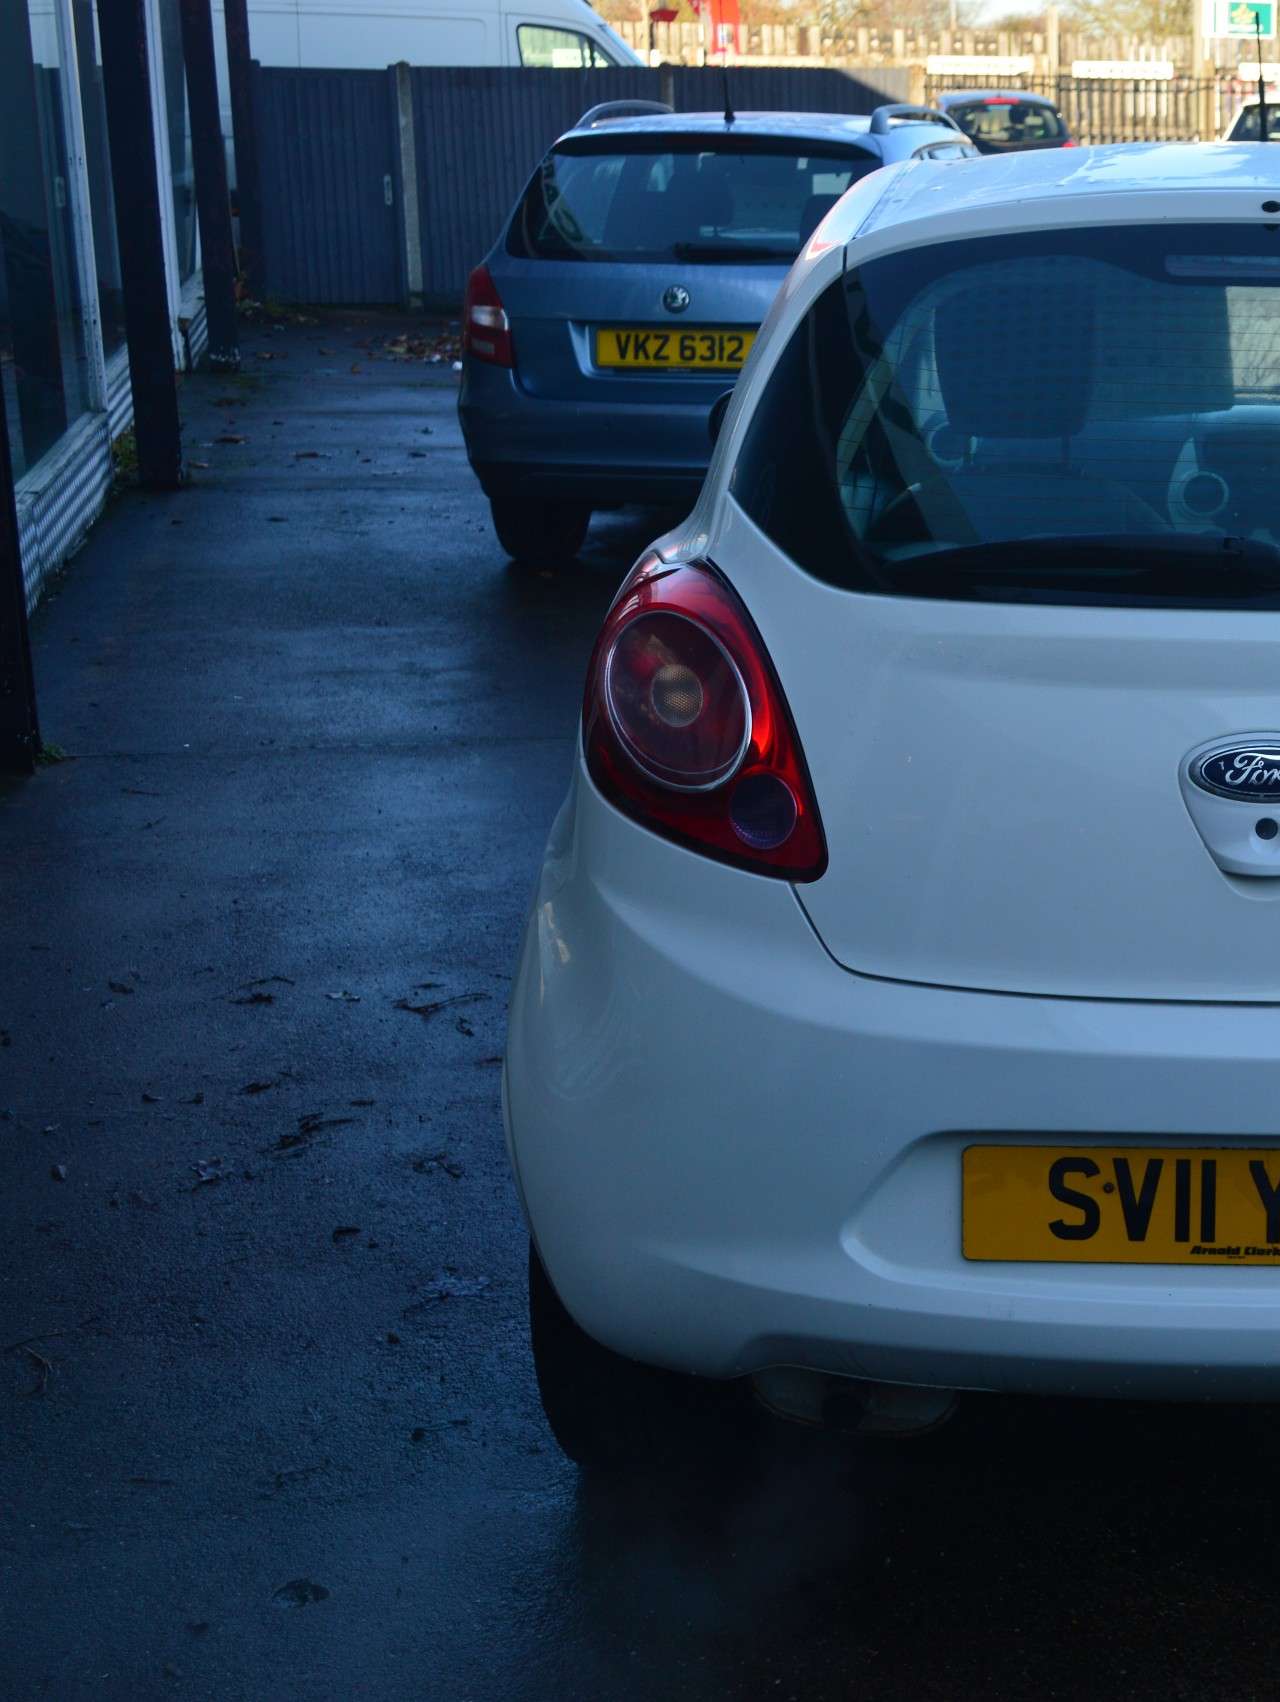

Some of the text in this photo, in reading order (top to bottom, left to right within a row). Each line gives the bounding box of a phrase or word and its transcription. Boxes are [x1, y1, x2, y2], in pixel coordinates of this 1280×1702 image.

[615, 333, 743, 362] VKZ 6312
[1048, 1156, 1217, 1243] SV11
[1190, 1245, 1240, 1256] Arnold
